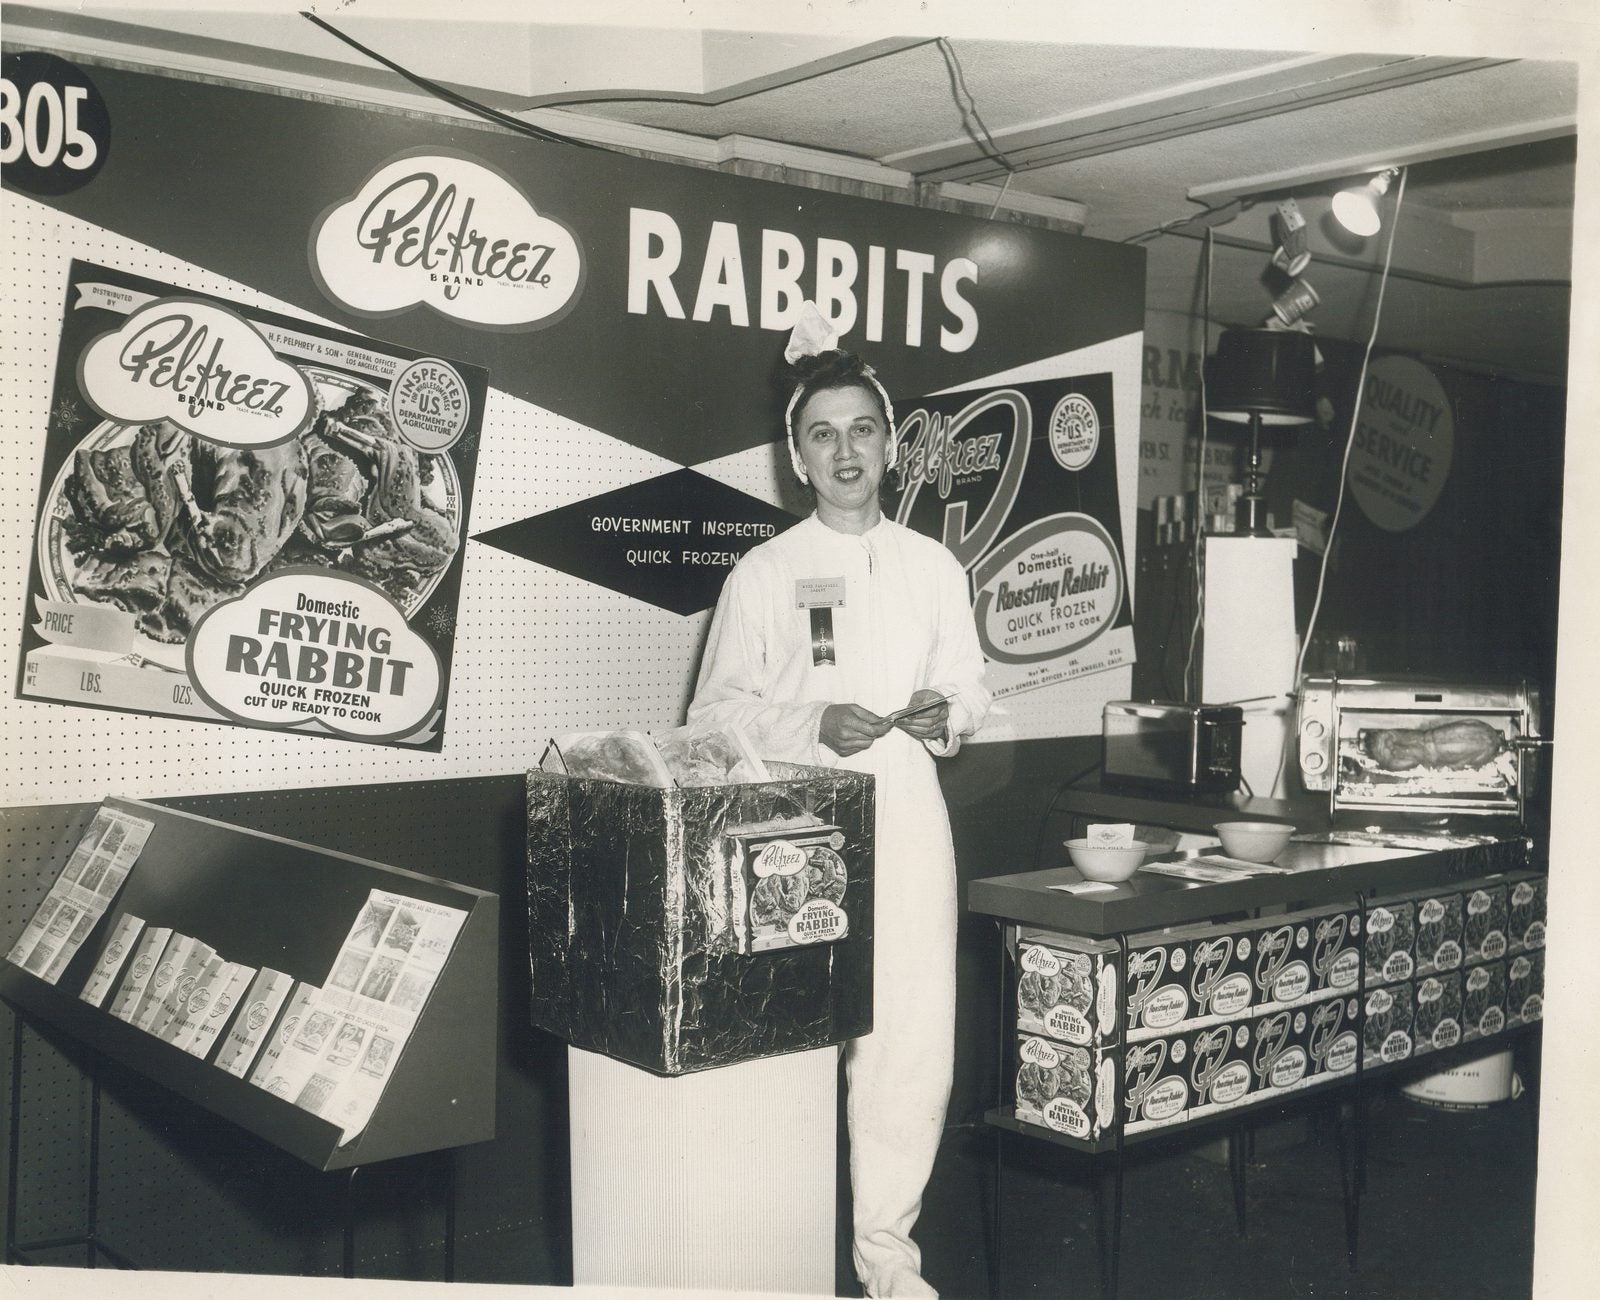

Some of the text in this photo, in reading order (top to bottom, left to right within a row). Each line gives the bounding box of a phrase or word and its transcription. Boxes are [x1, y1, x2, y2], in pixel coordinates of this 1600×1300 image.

[430, 273, 484, 287] BRAND
[627, 207, 979, 353] RABBITS
[92, 286, 132, 302] DISTRIBUTED
[106, 298, 116, 306] BY
[268, 332, 275, 341] H.
[276, 334, 282, 343] F.
[283, 336, 315, 351] PELPHREY
[317, 345, 322, 353] &
[346, 357, 356, 366] LOS
[380, 366, 396, 376] CALIF.
[347, 350, 397, 368] GENERAL OFFICES
[400, 368, 461, 410] INSPECTED
[177, 393, 225, 411] BRAND
[419, 393, 441, 416] U.S.
[1366, 374, 1443, 432] QUALITY
[399, 409, 457, 429] DEPARTMENT OF
[402, 418, 452, 436] AGRICULTURE
[1055, 402, 1093, 433] INSPECTED
[1354, 421, 1432, 483] SERVICE
[956, 475, 982, 485] BRAND
[591, 517, 775, 537] GOVERNMENT INSPECTED
[626, 550, 739, 566] QUICK FROZEN
[1017, 553, 1072, 575] Domestic
[996, 562, 1109, 613] Roasting Rabbit
[297, 592, 360, 619] Domestic
[44, 611, 75, 634] PRICE
[1007, 600, 1096, 632] QUICK FROZEN
[258, 608, 391, 655] FRYING
[1004, 616, 1100, 646] CUT UP READY TO COOK
[26, 662, 38, 674] NET
[225, 634, 414, 696] RABBIT
[80, 671, 193, 705] LBS. OZS.
[1015, 680, 1039, 691] GENERAL
[1041, 673, 1063, 683] OFFICES
[260, 681, 370, 707] QUICK FROZEN
[244, 695, 382, 723] CUT UP READY TO COOK
[796, 916, 840, 932] RABBIT
[802, 909, 834, 920] FRYING
[1050, 1018, 1085, 1034] RABBIT
[1055, 1013, 1081, 1025] FRYING
[1049, 1110, 1084, 1128] RABBIT
[1054, 1105, 1080, 1118] FRYING
